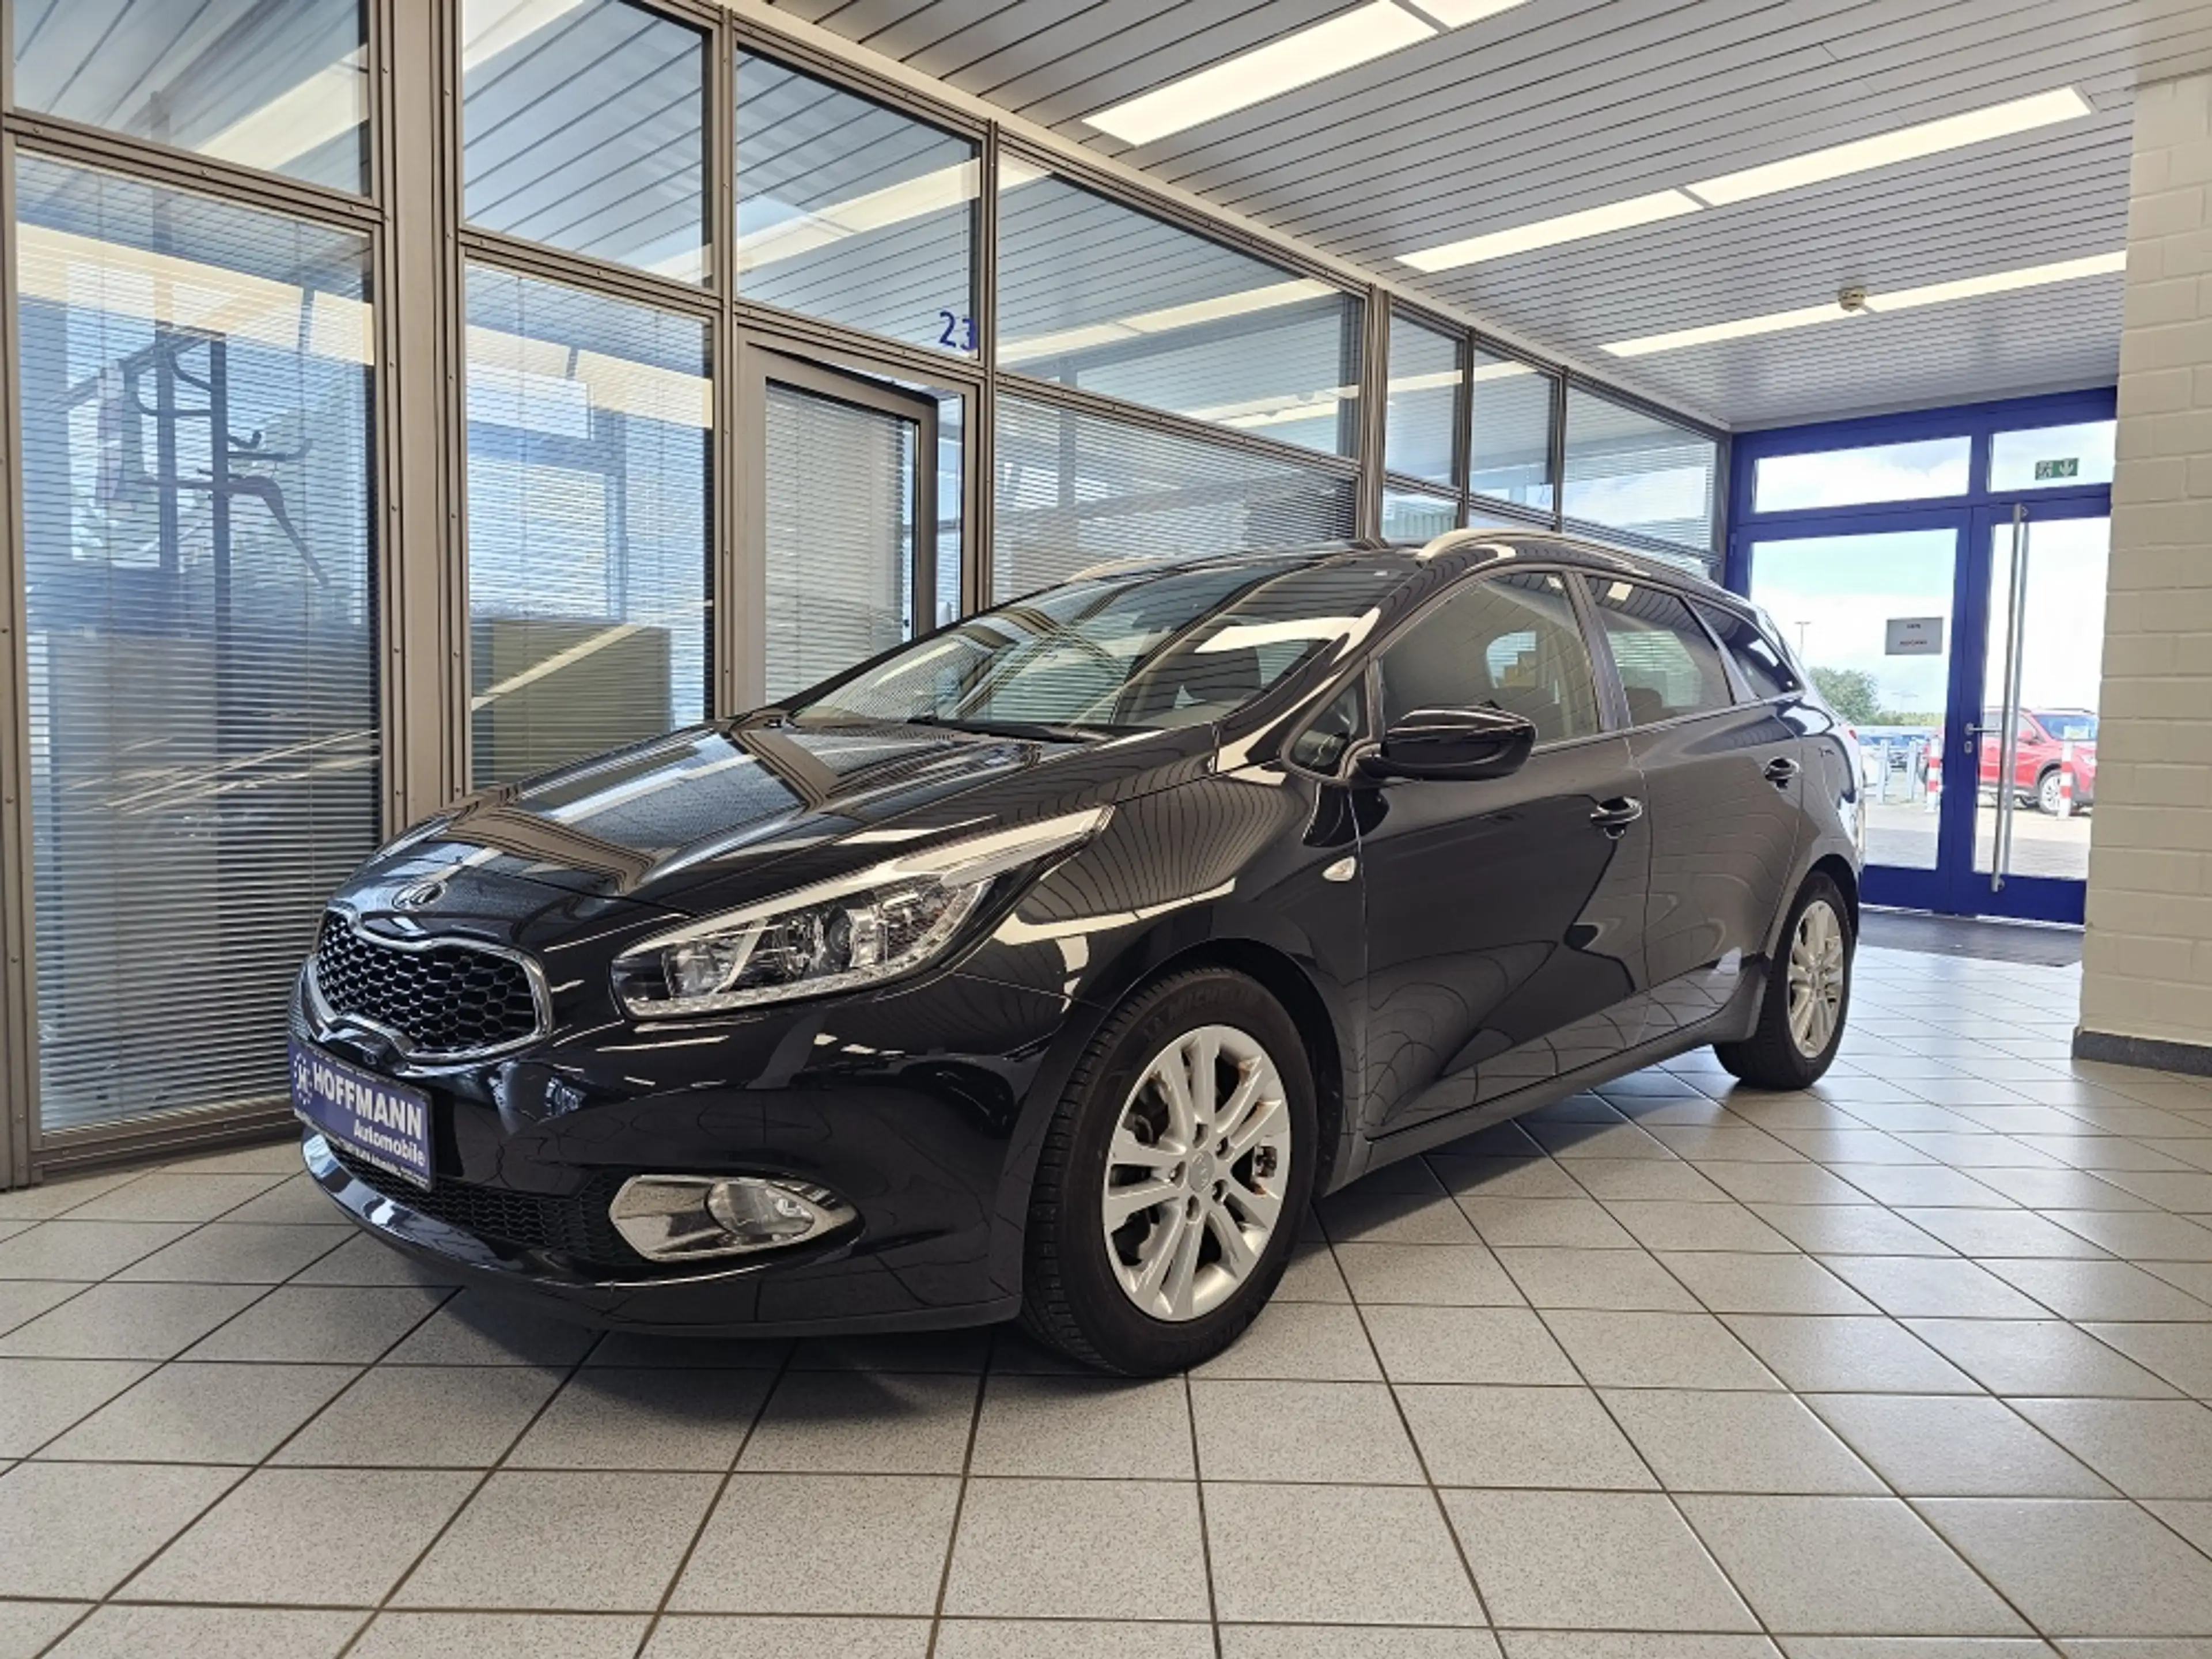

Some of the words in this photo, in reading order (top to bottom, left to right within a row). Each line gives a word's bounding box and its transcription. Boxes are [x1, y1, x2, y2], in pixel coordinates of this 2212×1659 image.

[938, 310, 976, 351] 23
[312, 1061, 422, 1140] HOFFMANN
[353, 1119, 426, 1167] Automobile
